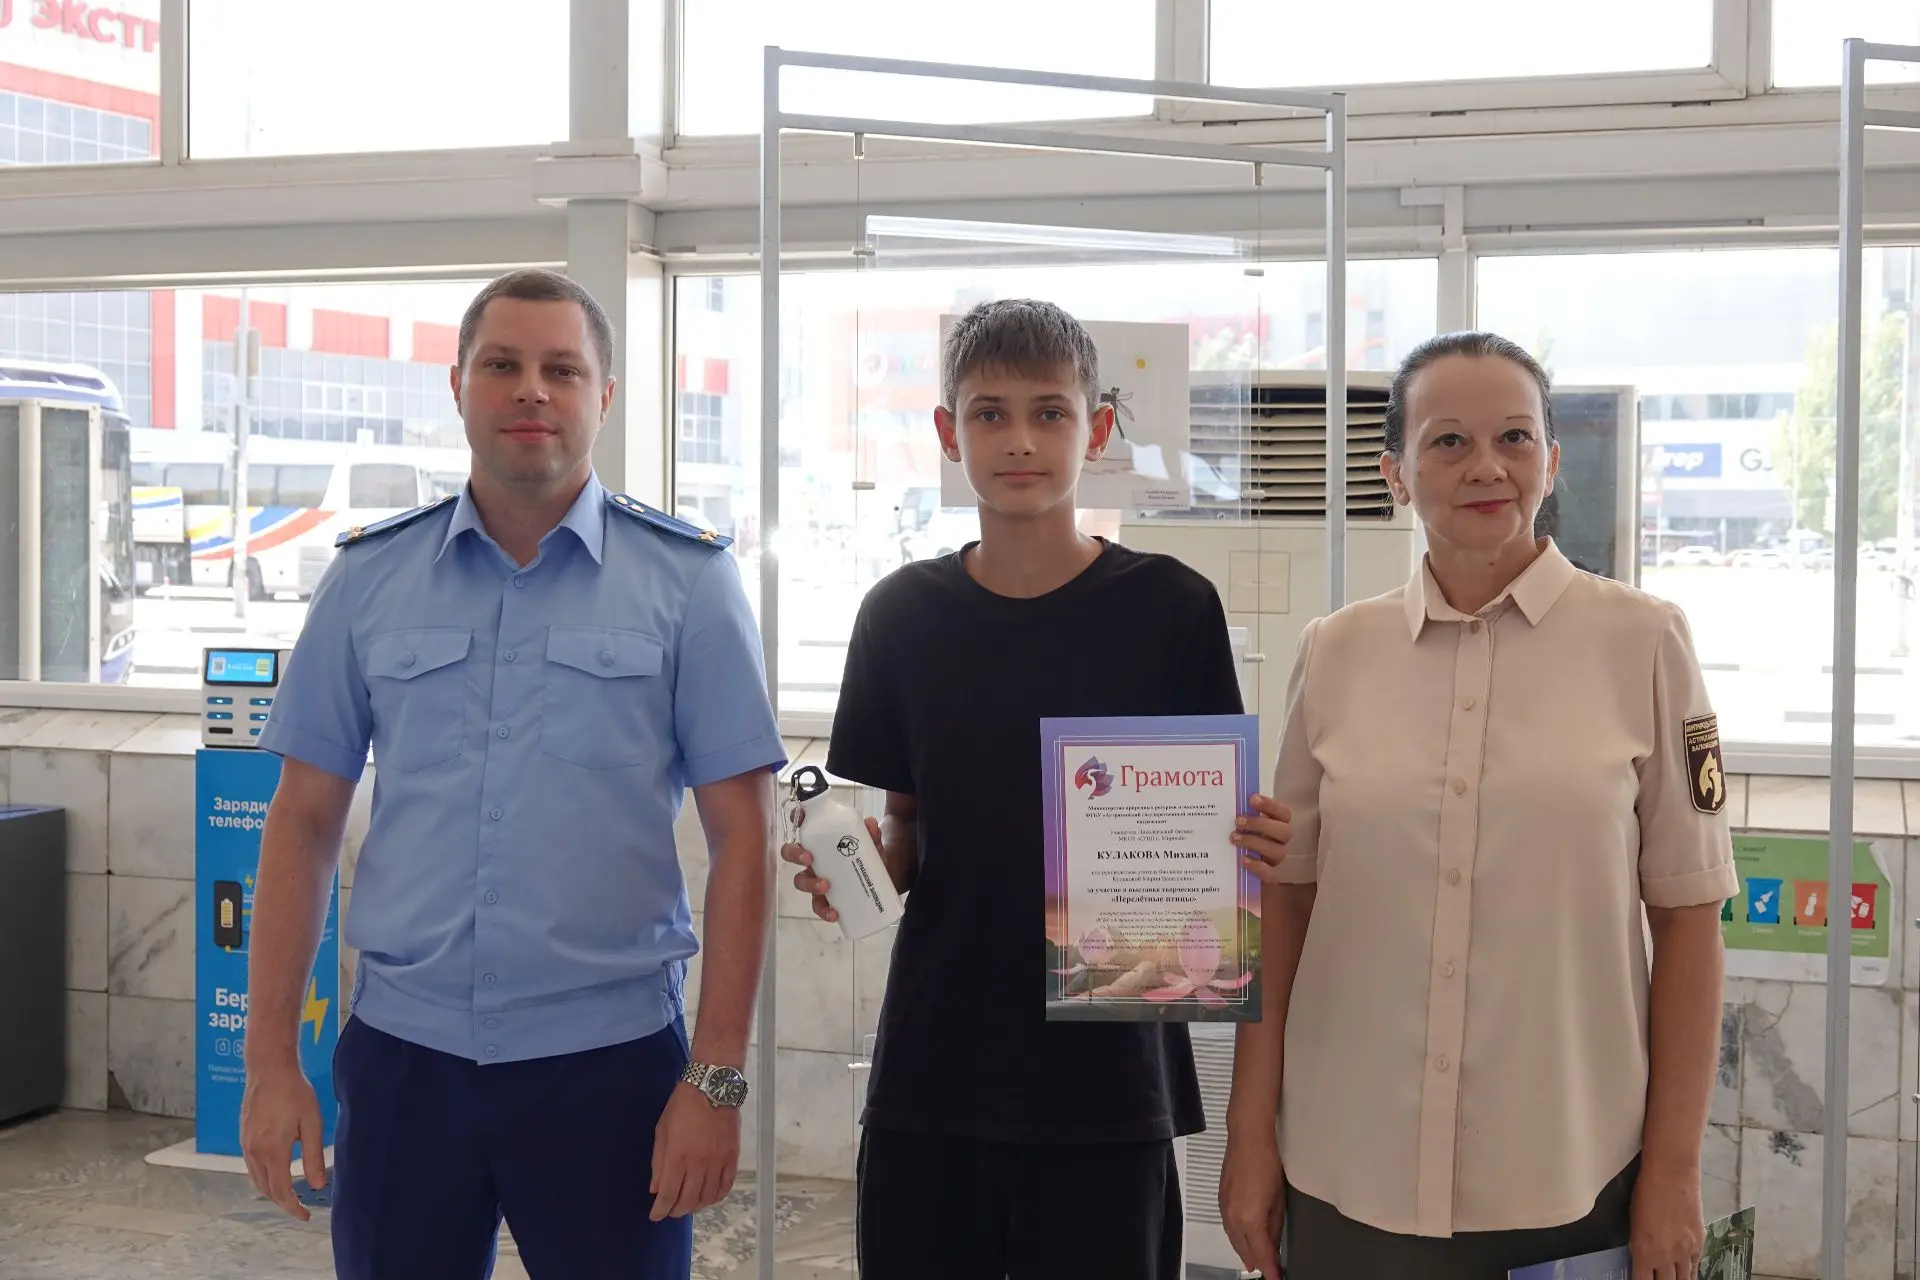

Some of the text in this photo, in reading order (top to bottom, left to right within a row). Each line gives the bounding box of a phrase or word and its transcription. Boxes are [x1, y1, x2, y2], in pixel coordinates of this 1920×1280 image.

[1120, 765, 1224, 793] Грамота
[1097, 850, 1209, 860] КУЛАКОВА Михаила
[1201, 885, 1220, 894] работ
[1111, 895, 1164, 904] «Перелётные
